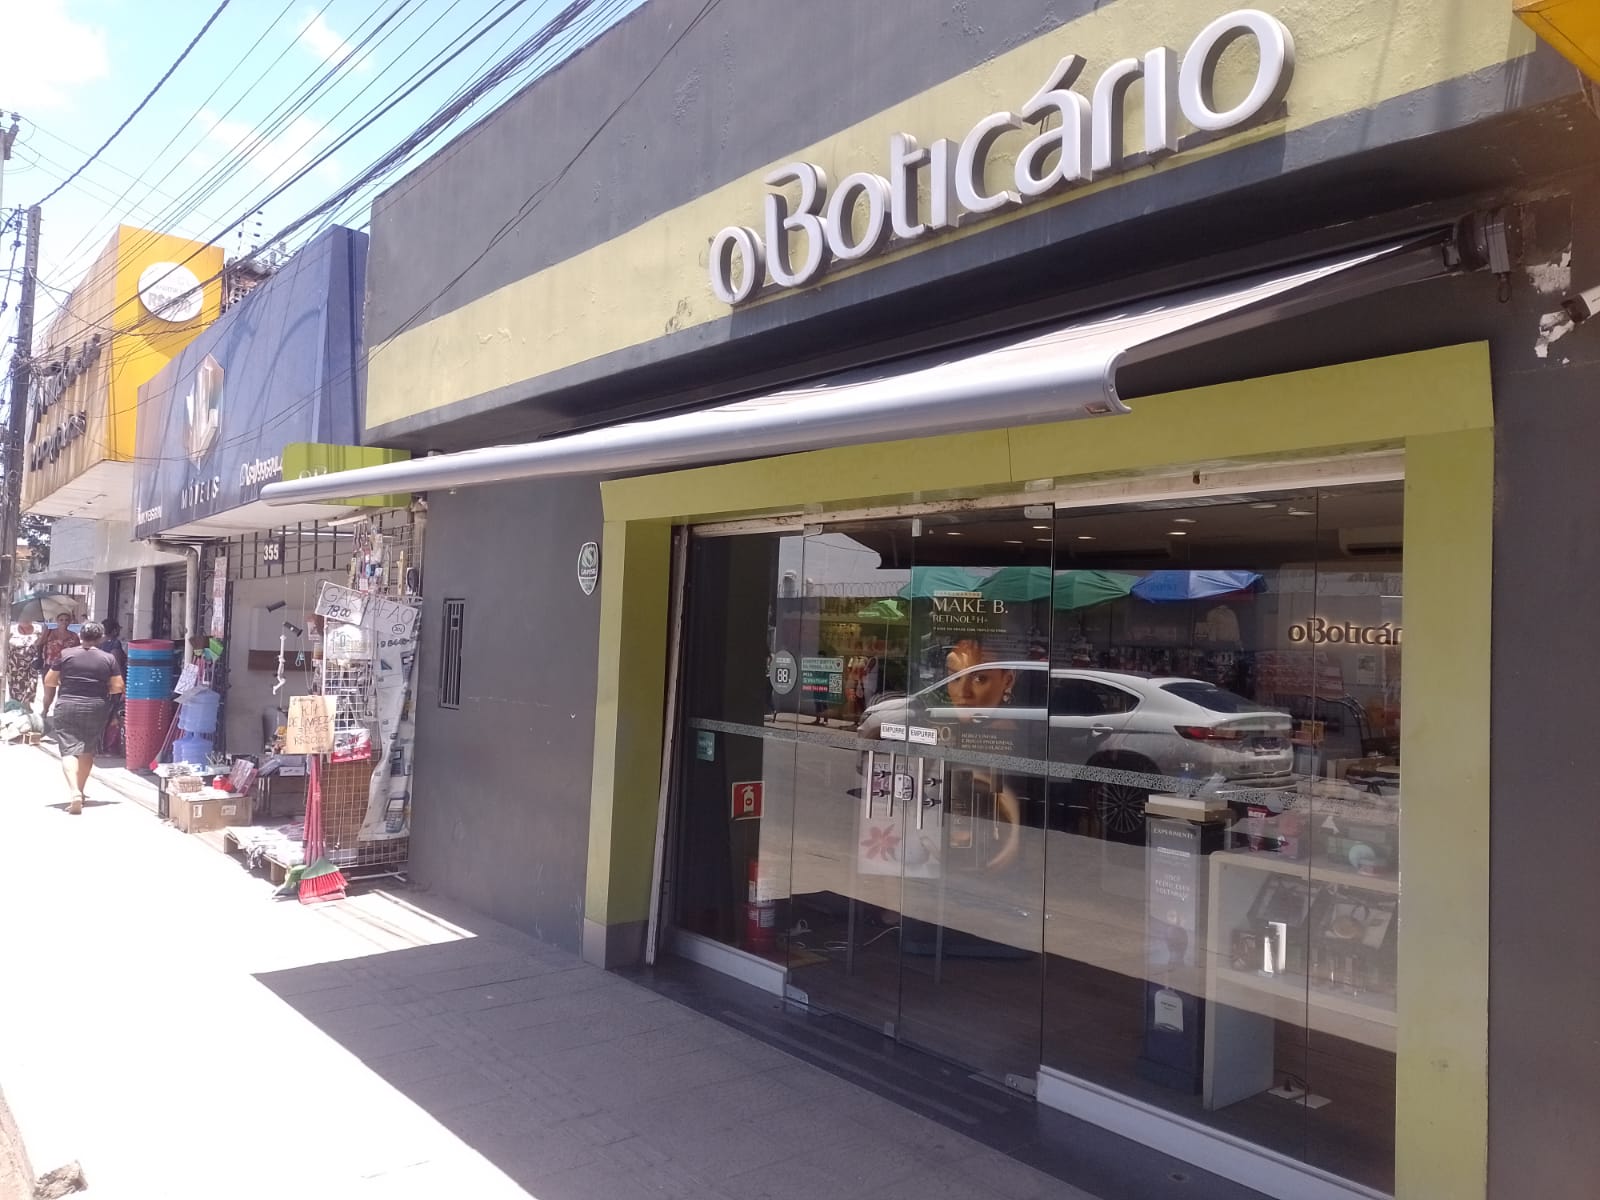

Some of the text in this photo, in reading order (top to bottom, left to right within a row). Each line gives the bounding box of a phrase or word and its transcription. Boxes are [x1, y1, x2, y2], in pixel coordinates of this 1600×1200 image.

[181, 475, 220, 509] MÓVEIS
[263, 543, 279, 561] 355
[932, 597, 1009, 614] MAKE B.
[910, 729, 935, 739] EMPURRE
